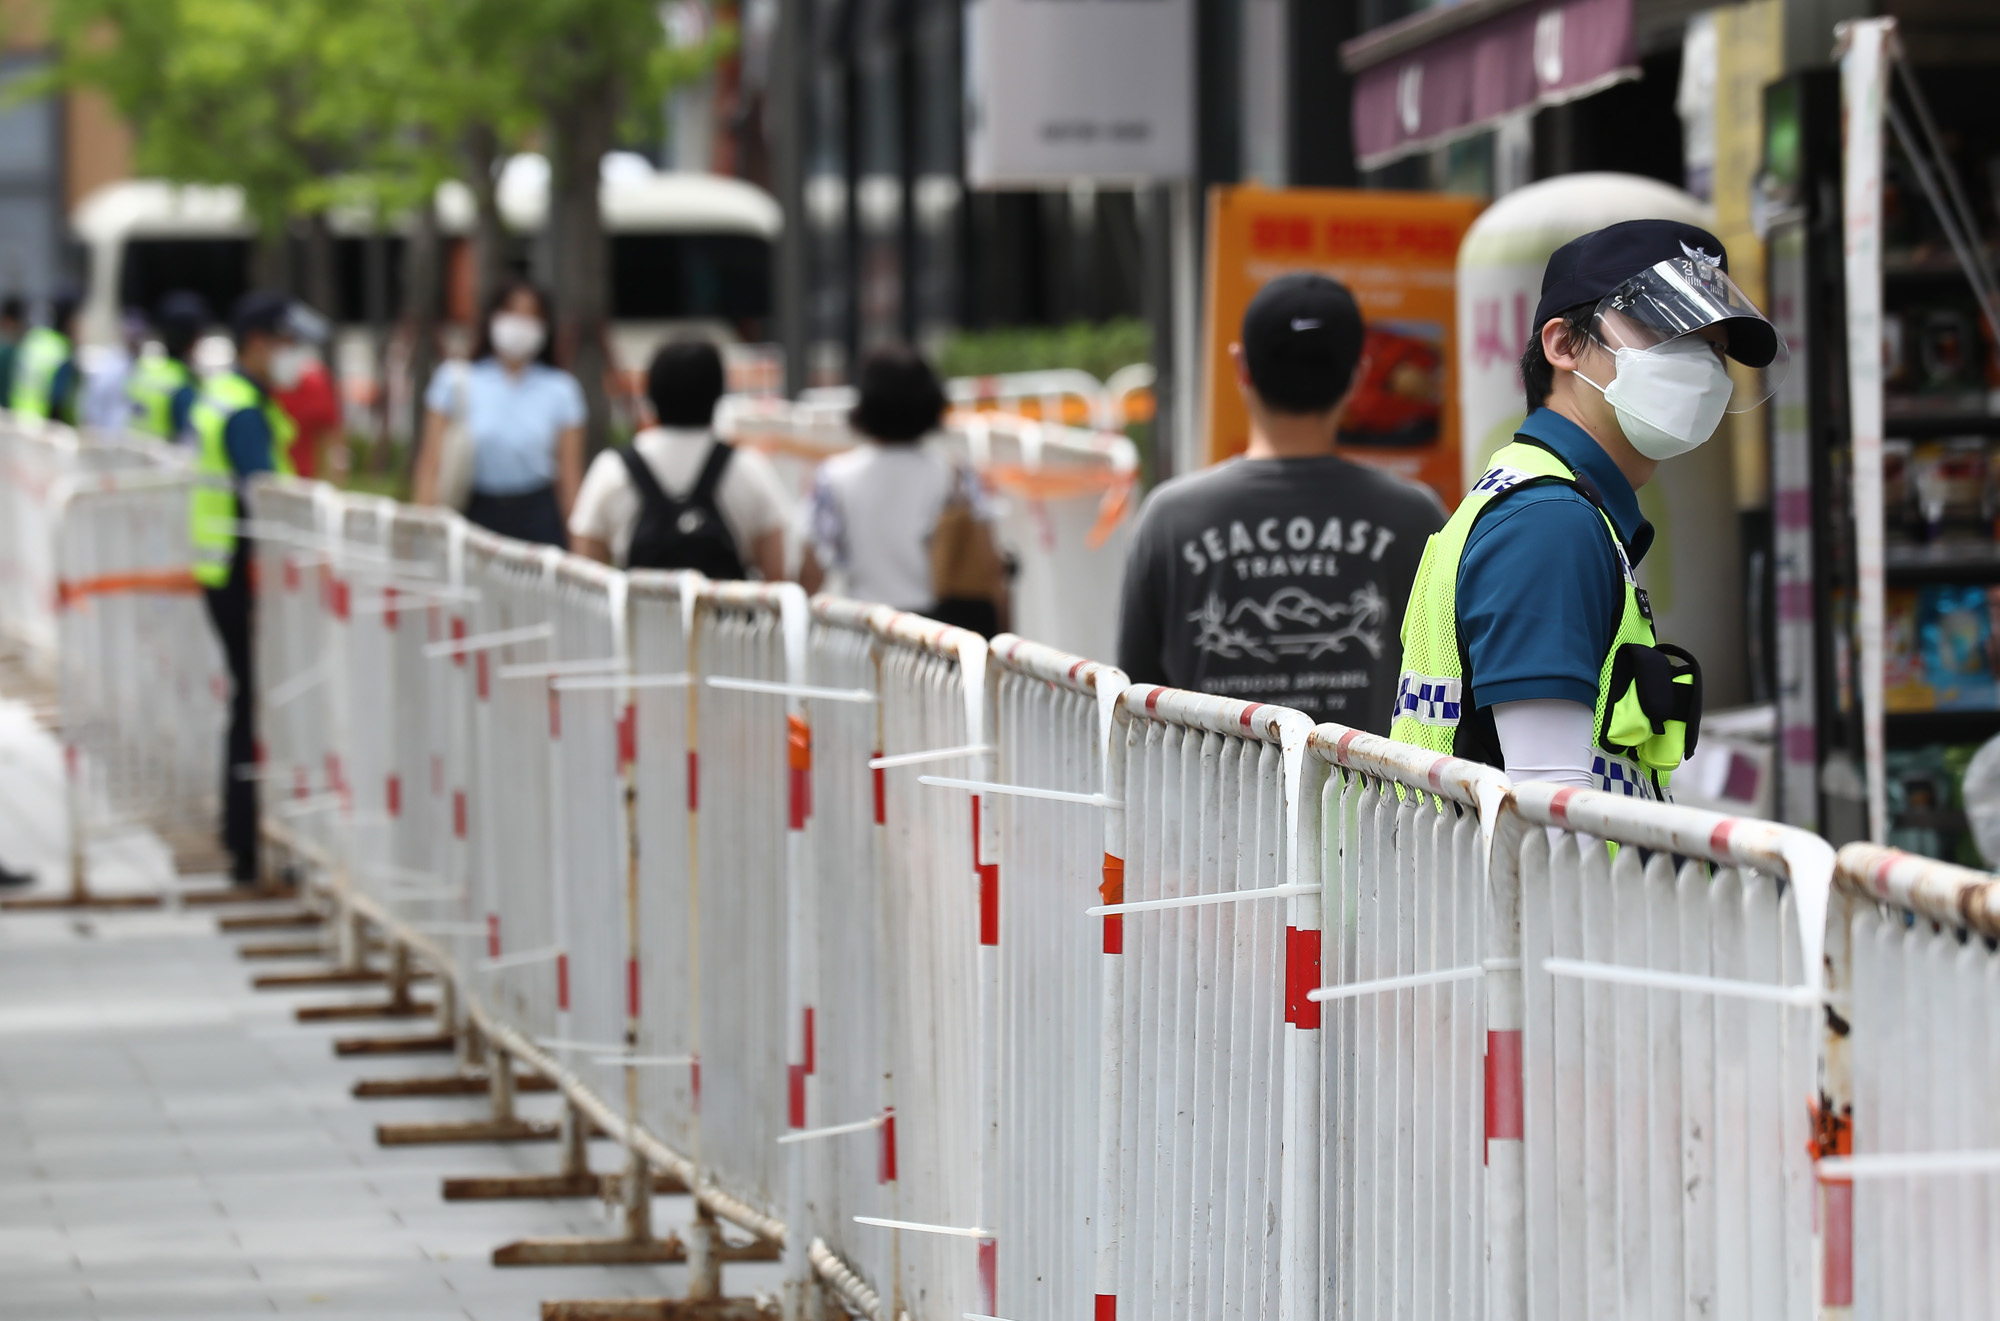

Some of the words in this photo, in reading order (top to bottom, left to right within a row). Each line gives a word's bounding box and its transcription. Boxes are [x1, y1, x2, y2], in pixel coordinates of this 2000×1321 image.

[1183, 516, 1395, 576] SEACOAST
[1234, 554, 1338, 580] TRAVEL
[1294, 670, 1370, 689] APPAREL
